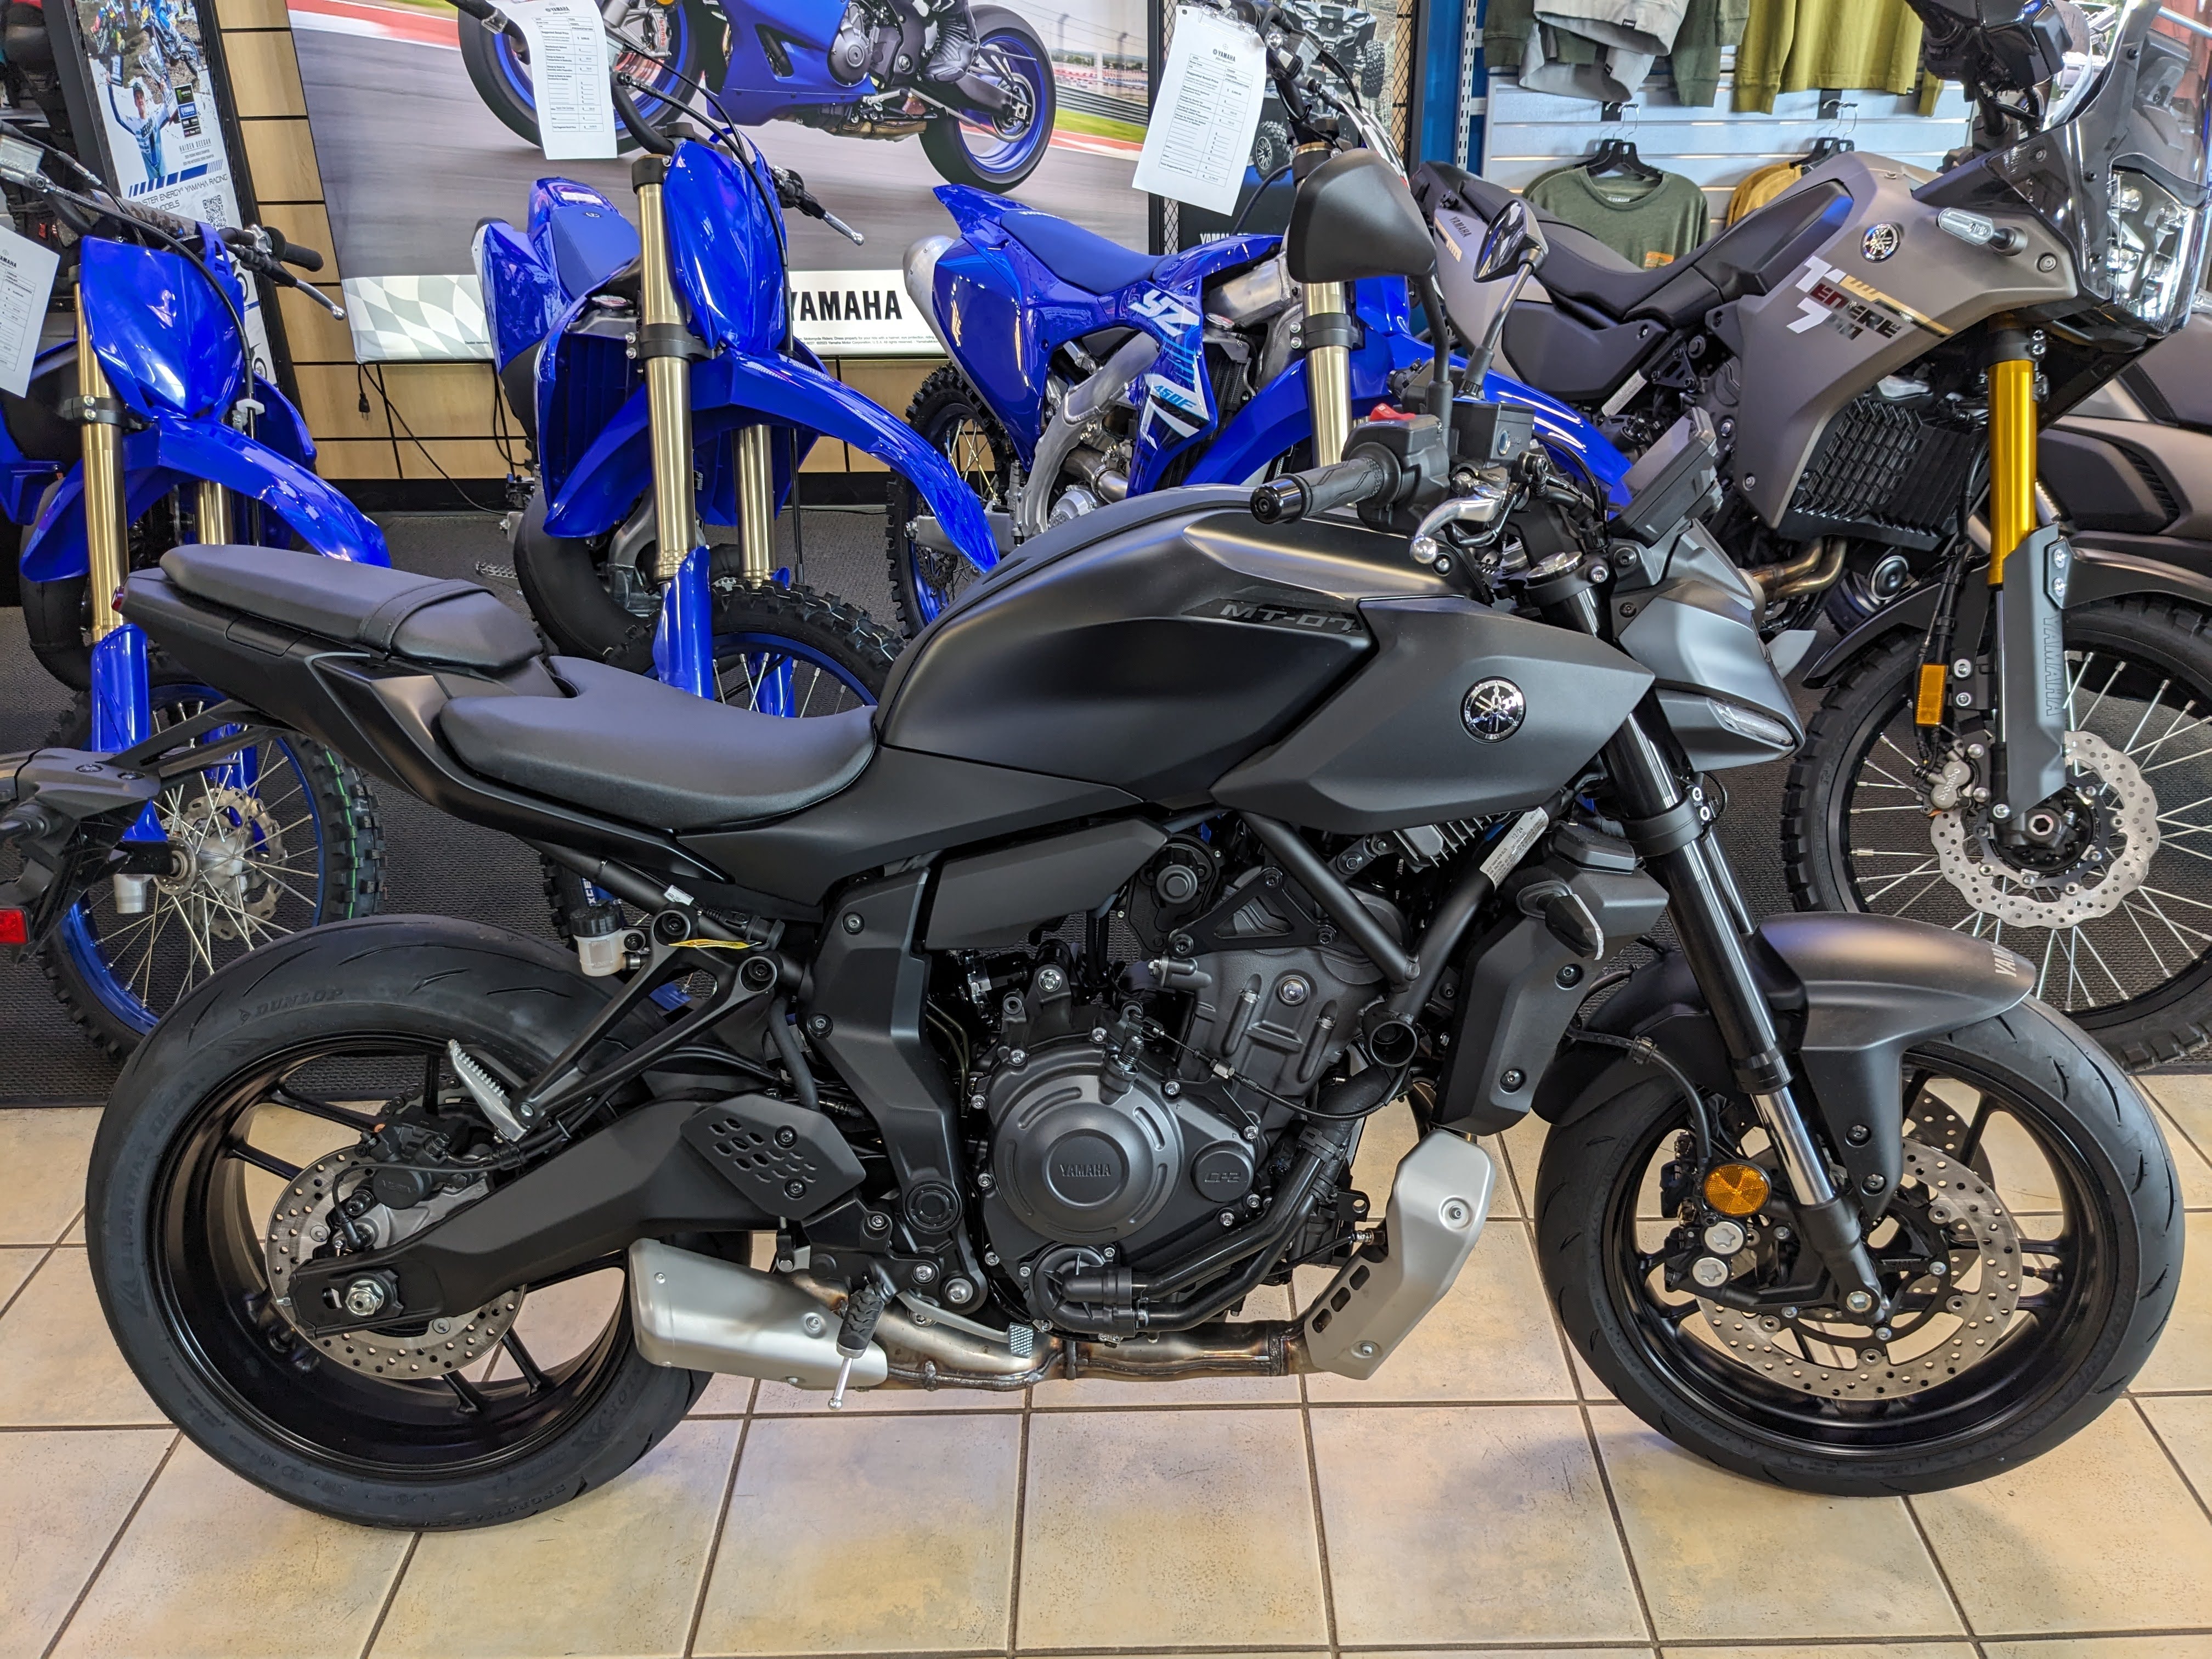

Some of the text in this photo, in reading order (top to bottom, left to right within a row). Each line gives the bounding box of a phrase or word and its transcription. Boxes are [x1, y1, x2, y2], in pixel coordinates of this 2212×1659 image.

[1218, 50, 1235, 62] YAMAHA
[179, 138, 211, 151] HAIDEN DEEGAN
[184, 180, 208, 193] YAMAHA
[210, 174, 228, 185] RACING
[1449, 216, 1472, 238] YAMAHA
[0, 256, 17, 268] AMAHA
[1128, 289, 1200, 337] YZ
[1154, 385, 1197, 408] 450F
[1220, 604, 1355, 631] MT-07
[2044, 616, 2064, 716] YAMAHA
[1937, 769, 1961, 801] brembo
[1511, 826, 1524, 839] 12/24
[583, 878, 597, 906] XCE
[1991, 945, 2017, 977] YAM
[1060, 1164, 1111, 1177] YAMAHA
